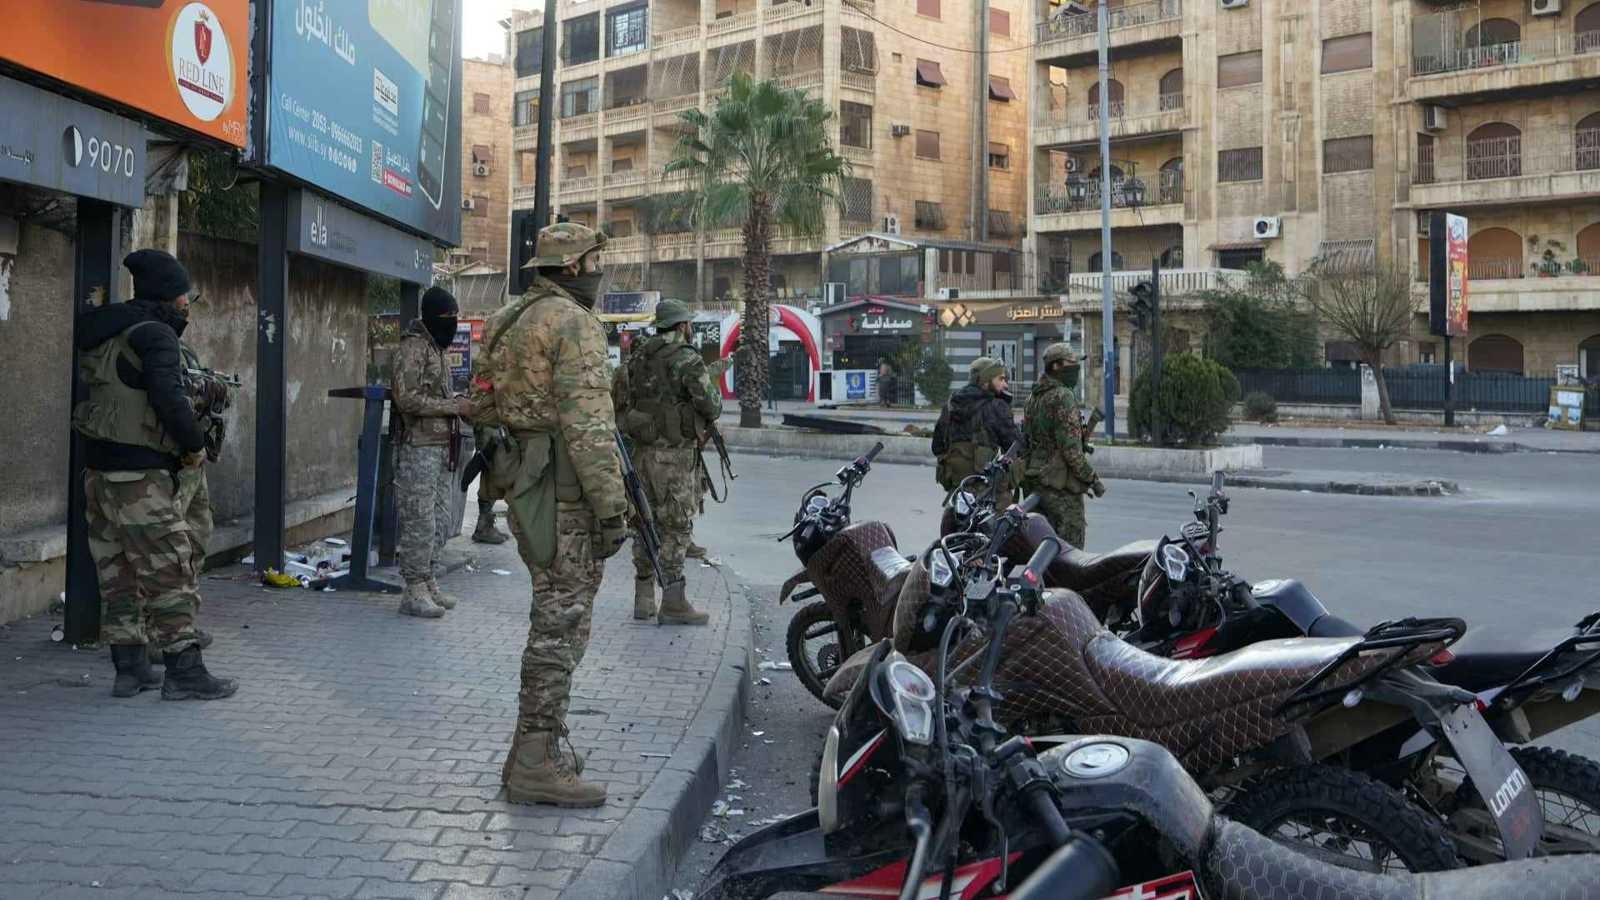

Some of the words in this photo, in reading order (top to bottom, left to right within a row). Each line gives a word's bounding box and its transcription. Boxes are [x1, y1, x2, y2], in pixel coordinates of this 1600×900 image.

[179, 56, 201, 85] RED
[201, 66, 225, 96] LINE
[88, 137, 134, 177] 9070
[861, 313, 913, 335] صيدلية
